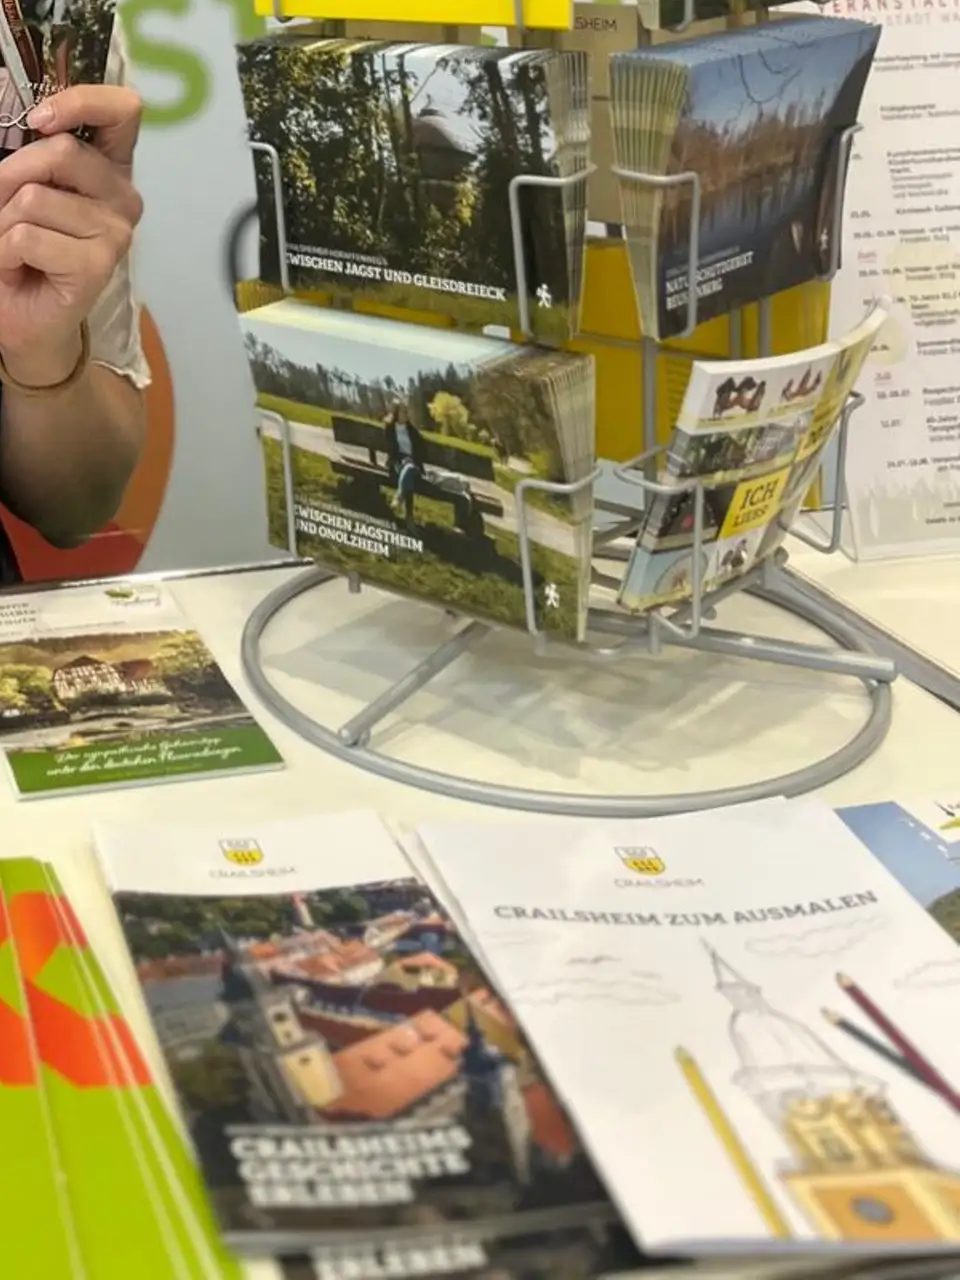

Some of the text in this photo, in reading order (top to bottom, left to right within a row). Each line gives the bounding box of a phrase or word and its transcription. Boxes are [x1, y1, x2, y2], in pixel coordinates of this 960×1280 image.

[344, 261, 382, 280] JAGST
[383, 268, 413, 284] UND
[413, 273, 507, 302] GLEISDREIECK
[739, 477, 779, 511] ICH
[319, 526, 390, 558] ONOLZHEIM
[353, 521, 423, 553] JAGSTHEIM
[493, 890, 880, 927] CRAILSHEIM ZUM AUSMALEN
